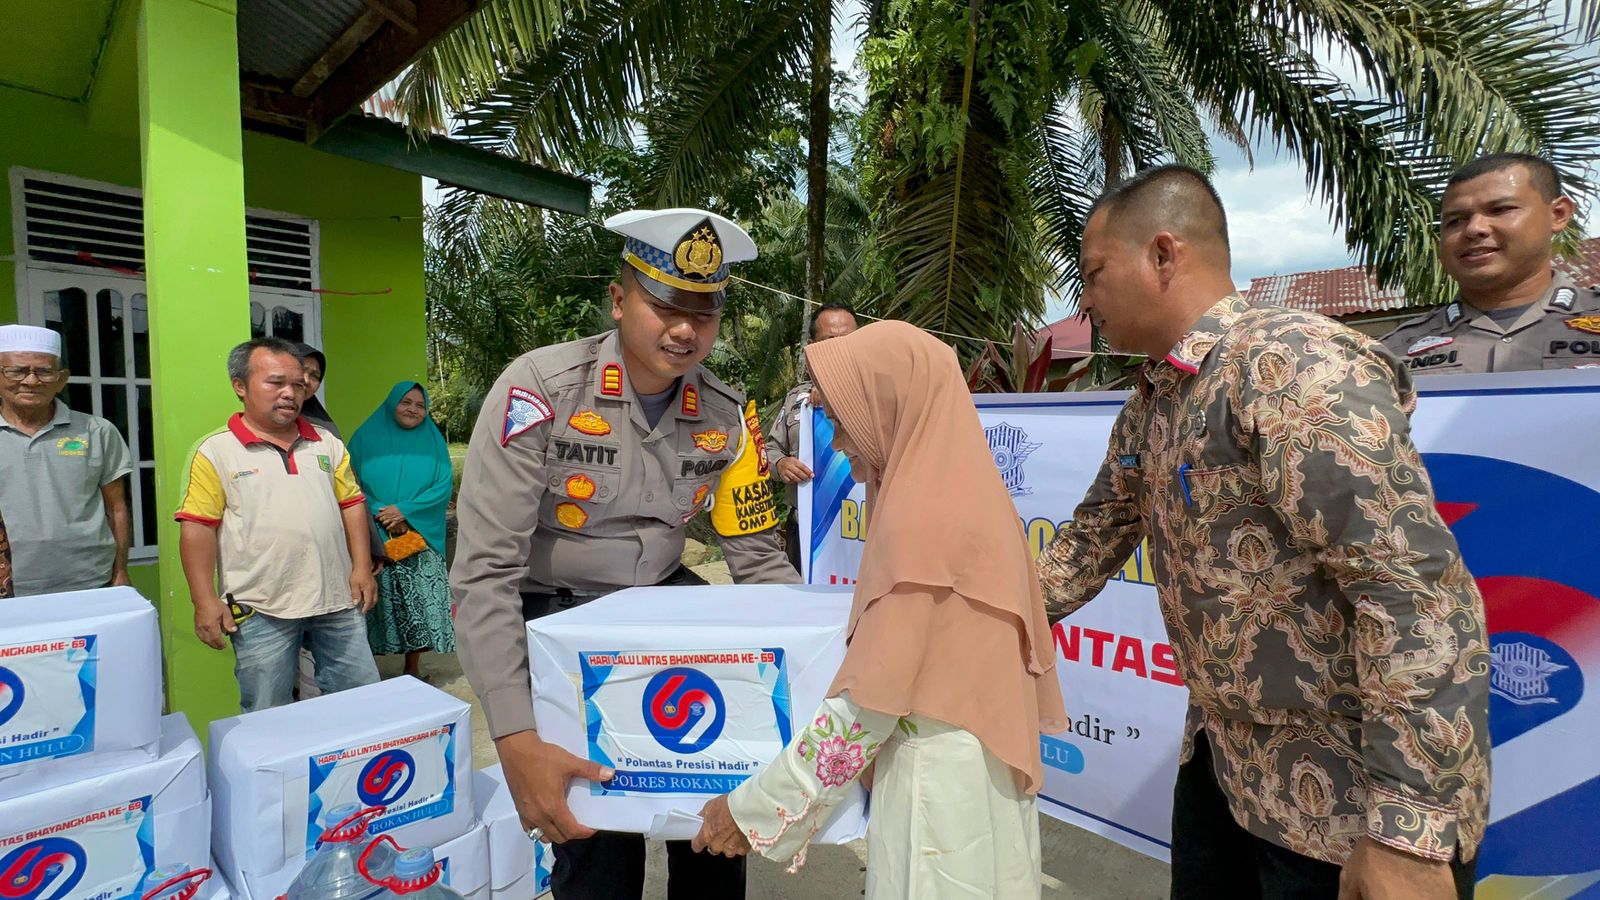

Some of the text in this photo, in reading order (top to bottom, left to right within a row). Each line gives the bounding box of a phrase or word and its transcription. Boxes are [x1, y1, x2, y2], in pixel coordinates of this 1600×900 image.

[1549, 340, 1600, 355] POL
[555, 440, 618, 466] TATIT
[0, 643, 48, 658] NGKARA
[71, 639, 86, 649] 69
[1051, 622, 1186, 688] NTAS
[589, 652, 776, 666] HARI LALU LINTAS BHAYANGKARA KE- 69
[11, 730, 49, 743] Hadir
[1066, 714, 1116, 746] dir
[19, 740, 72, 759] HULU
[317, 754, 337, 765] HARI
[337, 748, 357, 761] LALU
[357, 743, 382, 757] LINTAS
[1041, 741, 1070, 765] LU
[625, 757, 673, 769] Polantas
[676, 759, 715, 770] Presisi
[718, 760, 750, 771] Hadir
[611, 774, 666, 789] POLRES
[670, 776, 723, 790] ROKAN
[408, 795, 429, 808] Hadir
[0, 835, 24, 848] TAS
[25, 810, 107, 841] BHAYANGKARA
[127, 801, 142, 812] 69
[371, 815, 410, 833] ROKAN
[411, 803, 442, 820] HULU
